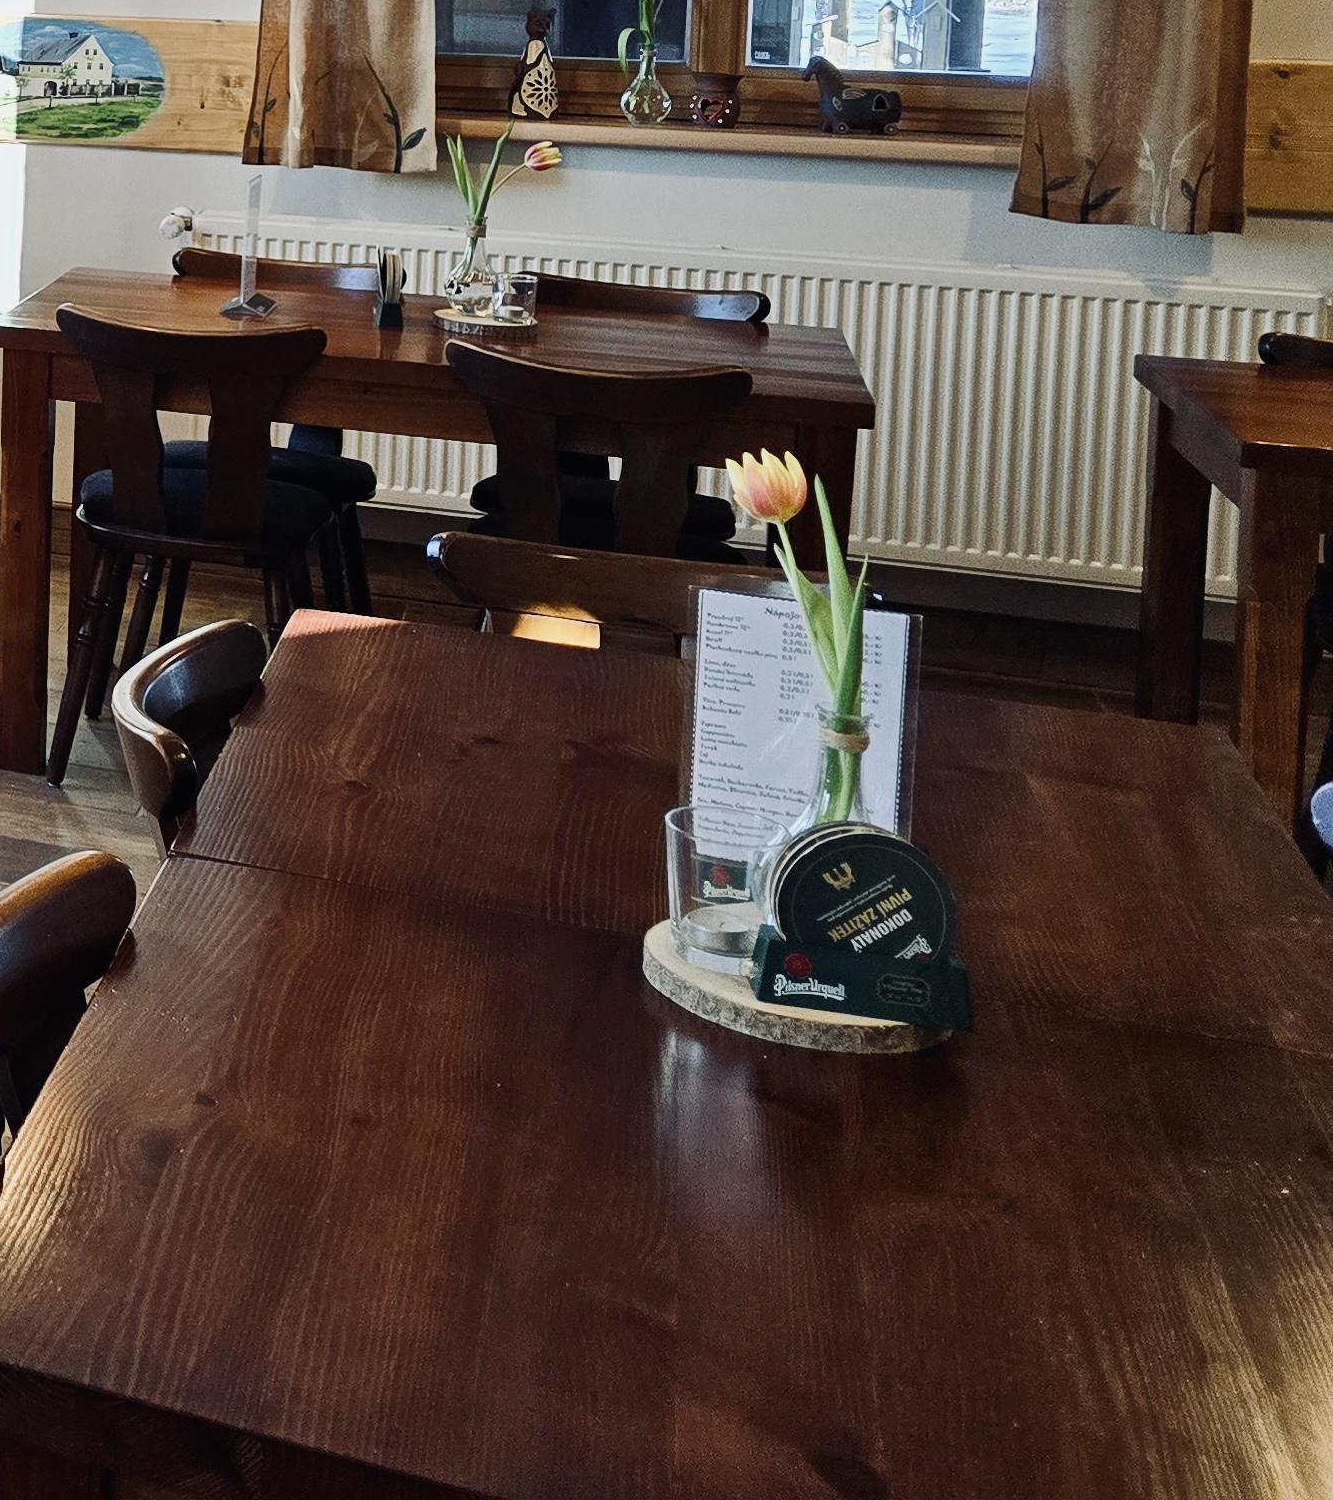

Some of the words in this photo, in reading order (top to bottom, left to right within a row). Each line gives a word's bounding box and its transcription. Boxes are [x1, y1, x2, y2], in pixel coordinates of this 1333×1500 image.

[875, 887, 913, 918] PIVNÍ
[827, 907, 879, 943] ZÁŽITEK
[850, 908, 913, 954] DOKONALÝ
[773, 973, 810, 997] Pilsner
[808, 977, 846, 1000] Urquell
